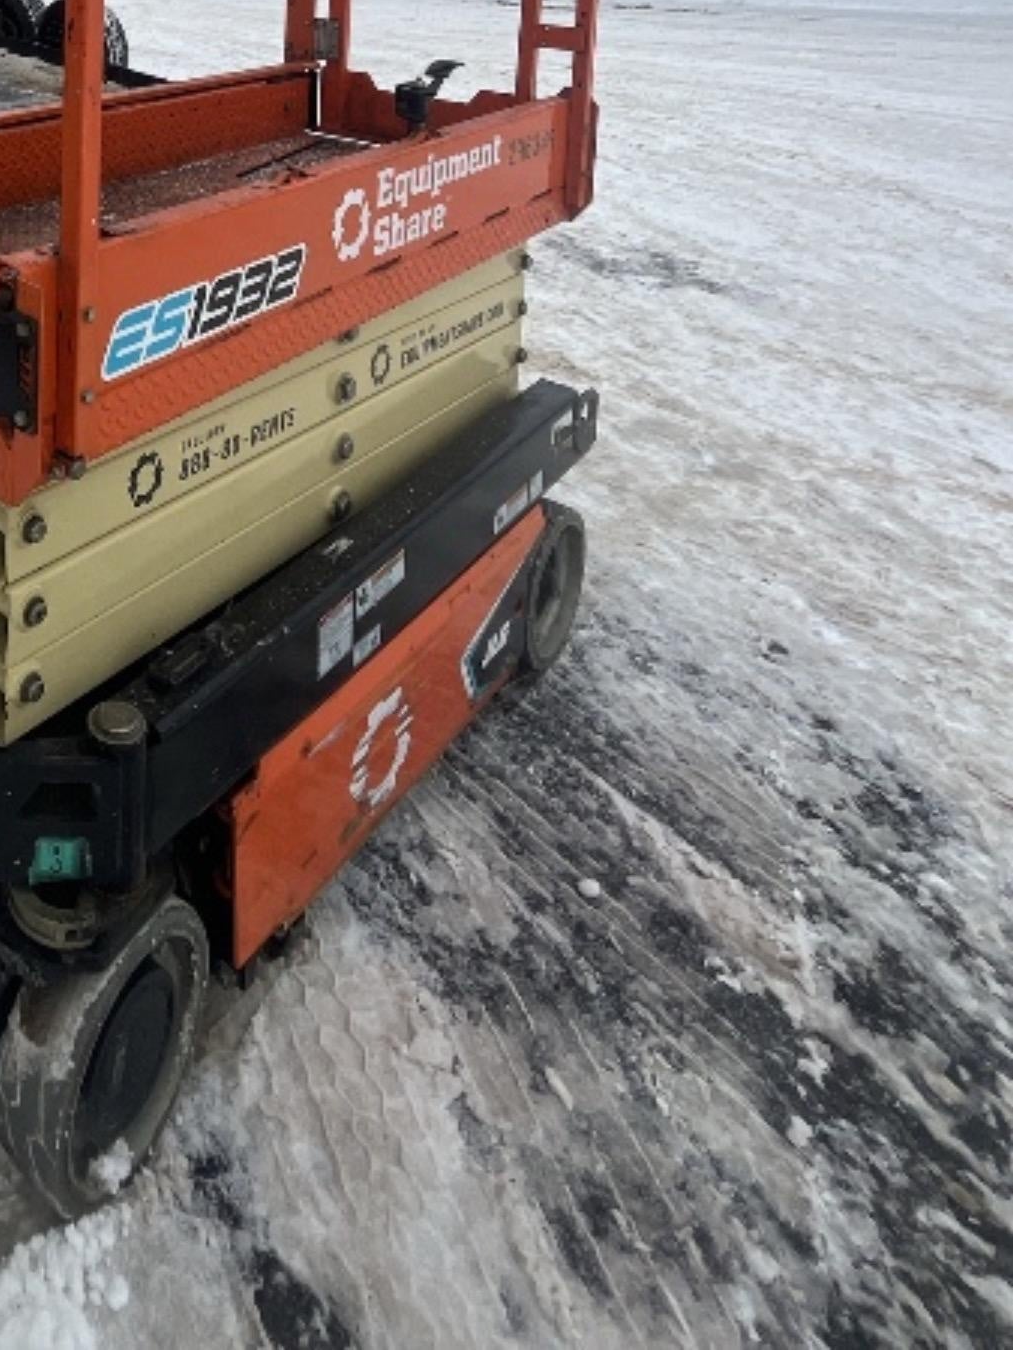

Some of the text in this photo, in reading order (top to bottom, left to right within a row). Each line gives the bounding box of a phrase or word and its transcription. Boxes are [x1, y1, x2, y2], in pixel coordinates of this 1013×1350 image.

[376, 134, 502, 209] Equipment
[372, 202, 447, 257] Share
[101, 242, 307, 382] ES1932
